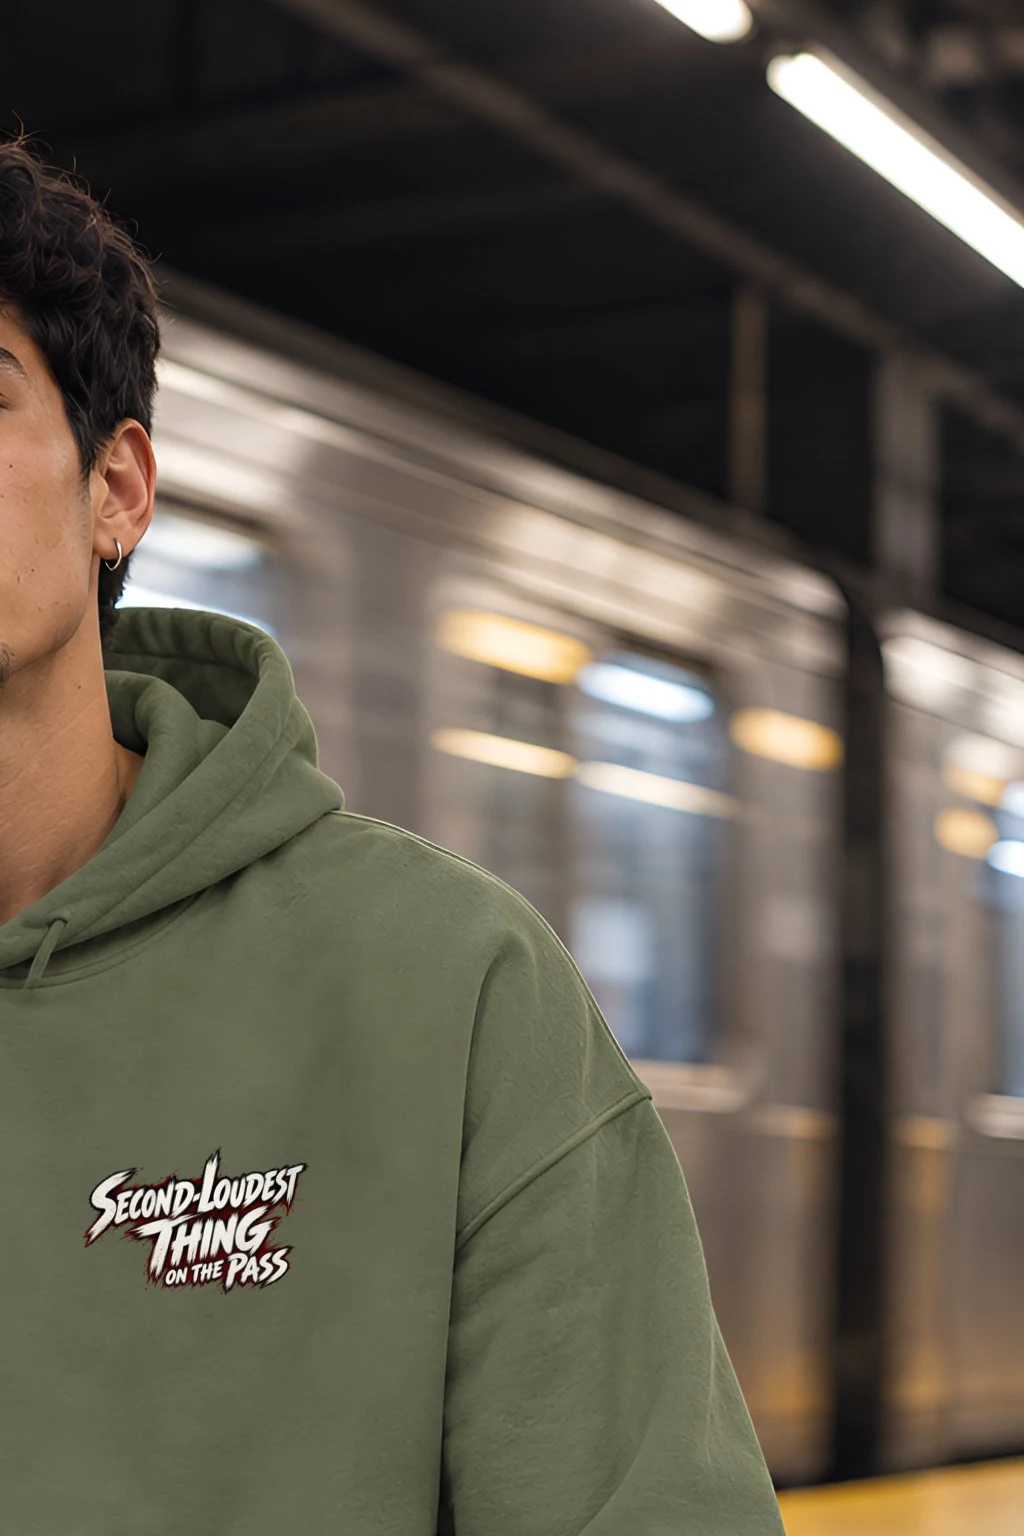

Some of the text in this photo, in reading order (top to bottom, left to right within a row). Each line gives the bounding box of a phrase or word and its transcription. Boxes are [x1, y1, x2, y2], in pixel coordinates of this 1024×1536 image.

[87, 1150, 306, 1243] SECOND-LOUDEST
[130, 1204, 274, 1280] THING
[165, 1248, 291, 1290] ON THE PASS
